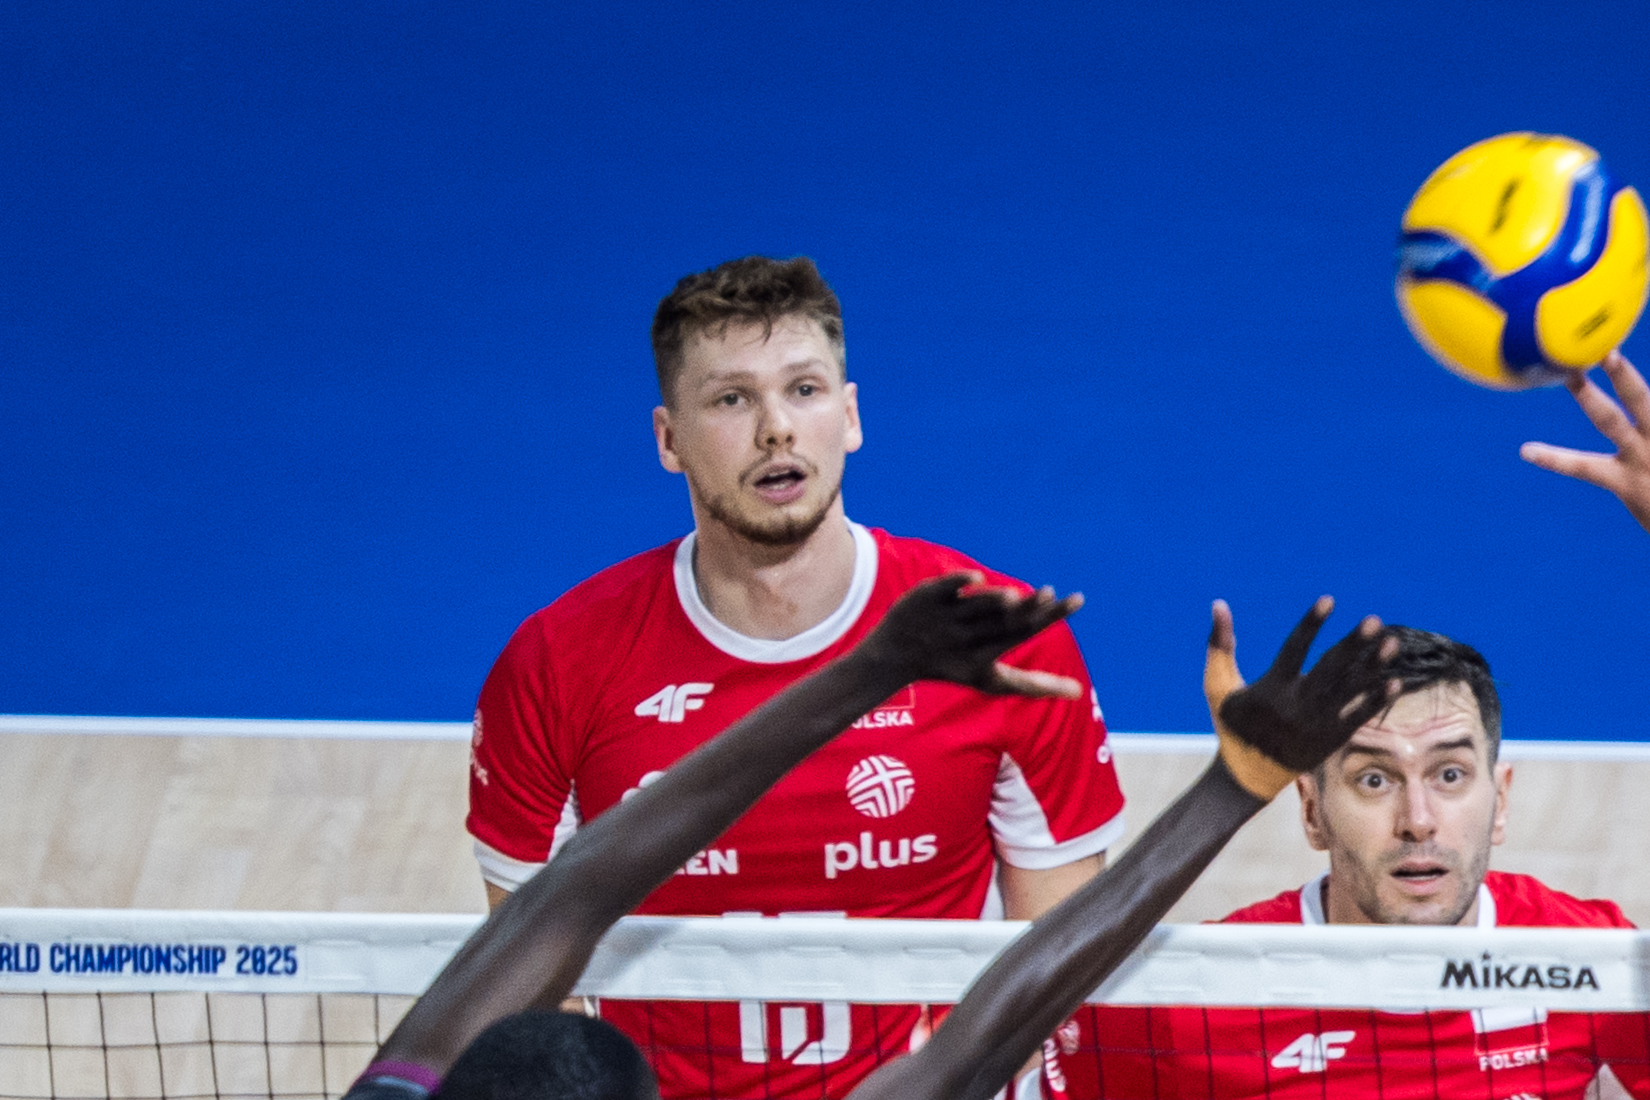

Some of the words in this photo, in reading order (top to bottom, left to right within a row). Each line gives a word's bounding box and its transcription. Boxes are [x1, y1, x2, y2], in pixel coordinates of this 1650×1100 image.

[634, 682, 715, 723] 4F
[824, 831, 938, 879] plus
[0, 942, 40, 972] RLD
[50, 943, 226, 973] CHAMPIONSHIP
[236, 944, 297, 975] 2025
[1271, 1030, 1356, 1073] 4F
[1479, 1048, 1549, 1072] POLSKA
